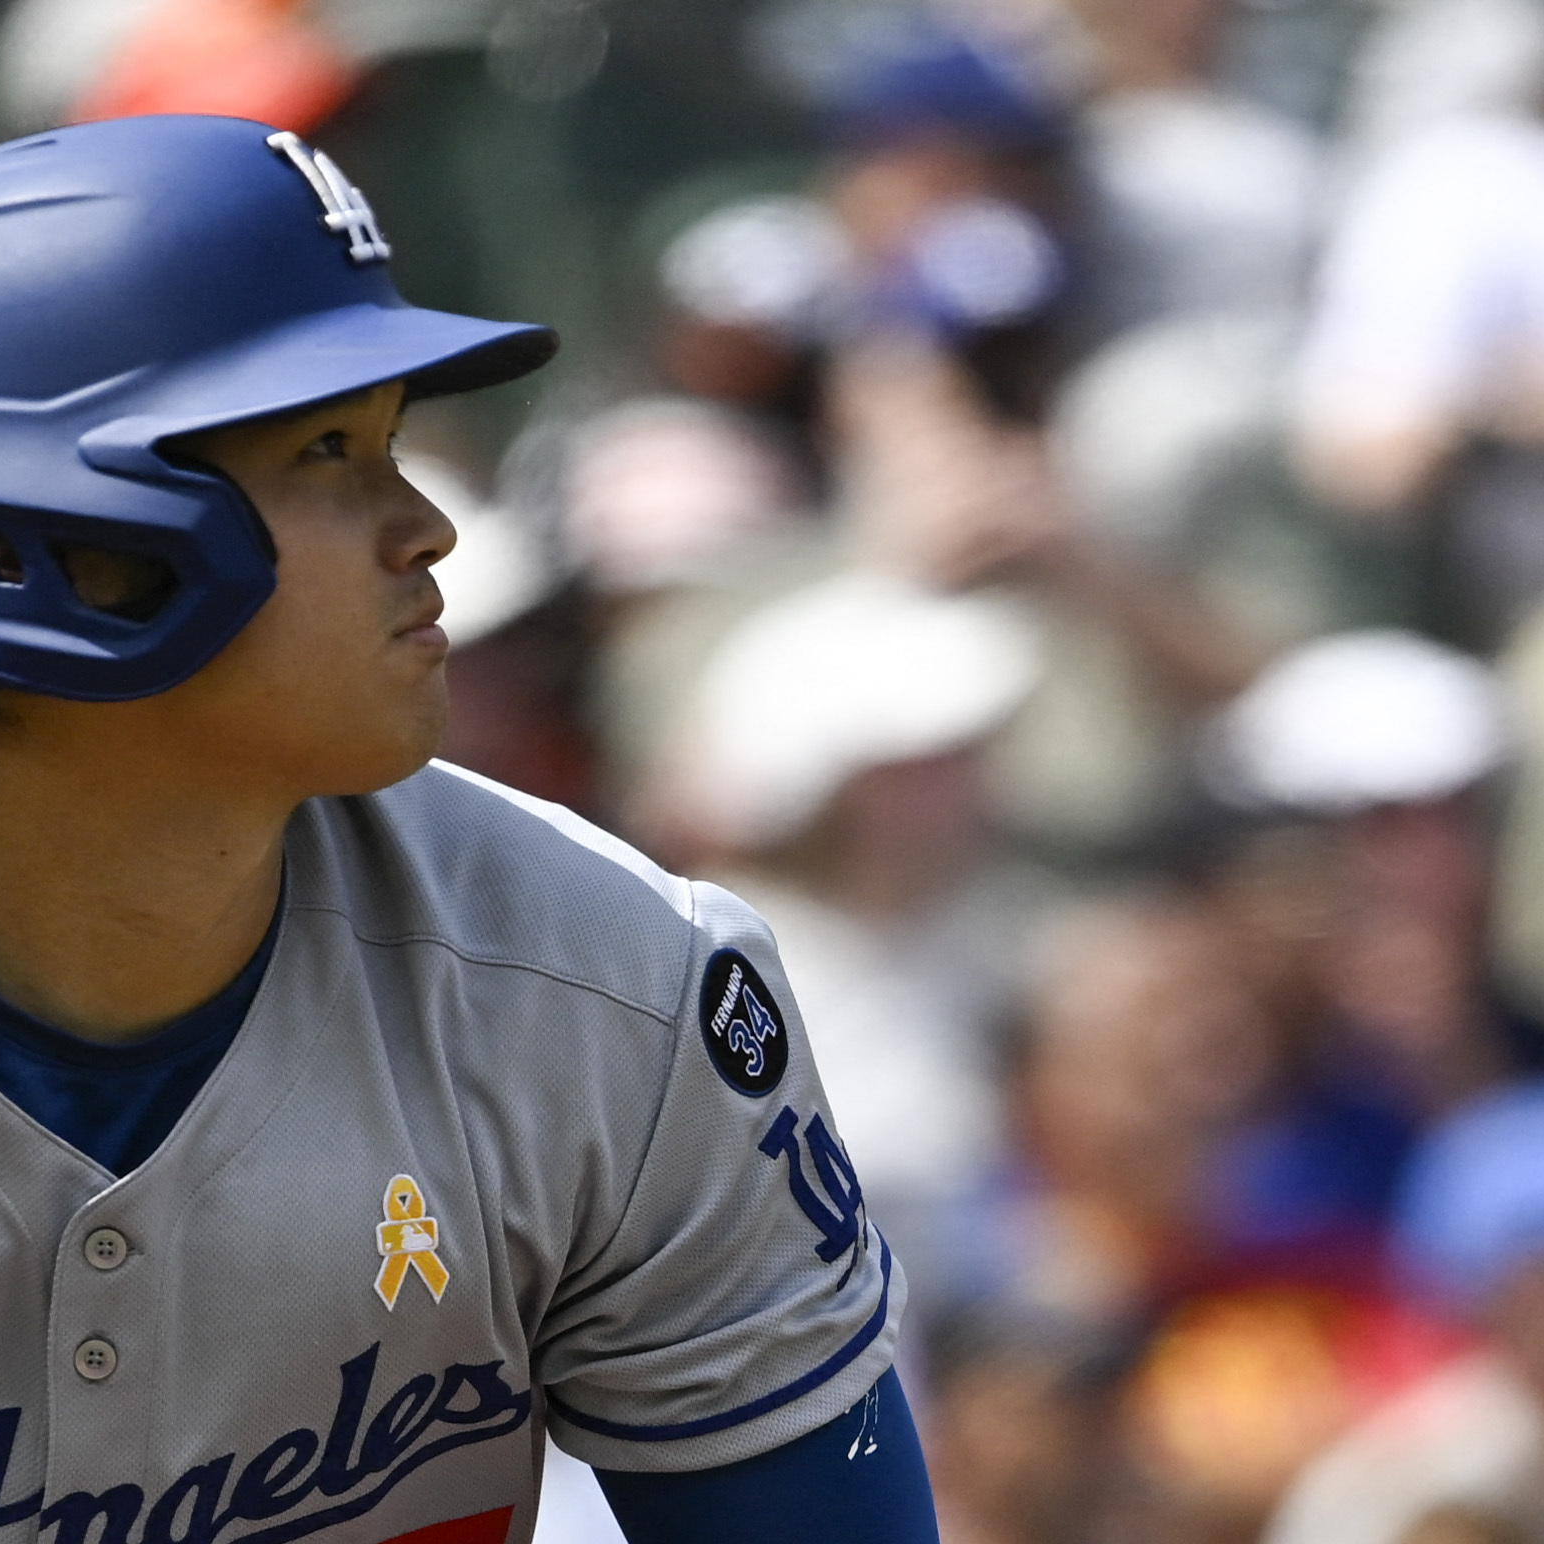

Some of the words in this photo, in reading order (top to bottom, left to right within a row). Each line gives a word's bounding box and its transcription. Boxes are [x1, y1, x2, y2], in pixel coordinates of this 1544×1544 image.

[266, 130, 391, 261] LA
[710, 962, 744, 1037] FERNANDO
[727, 983, 778, 1077] 34
